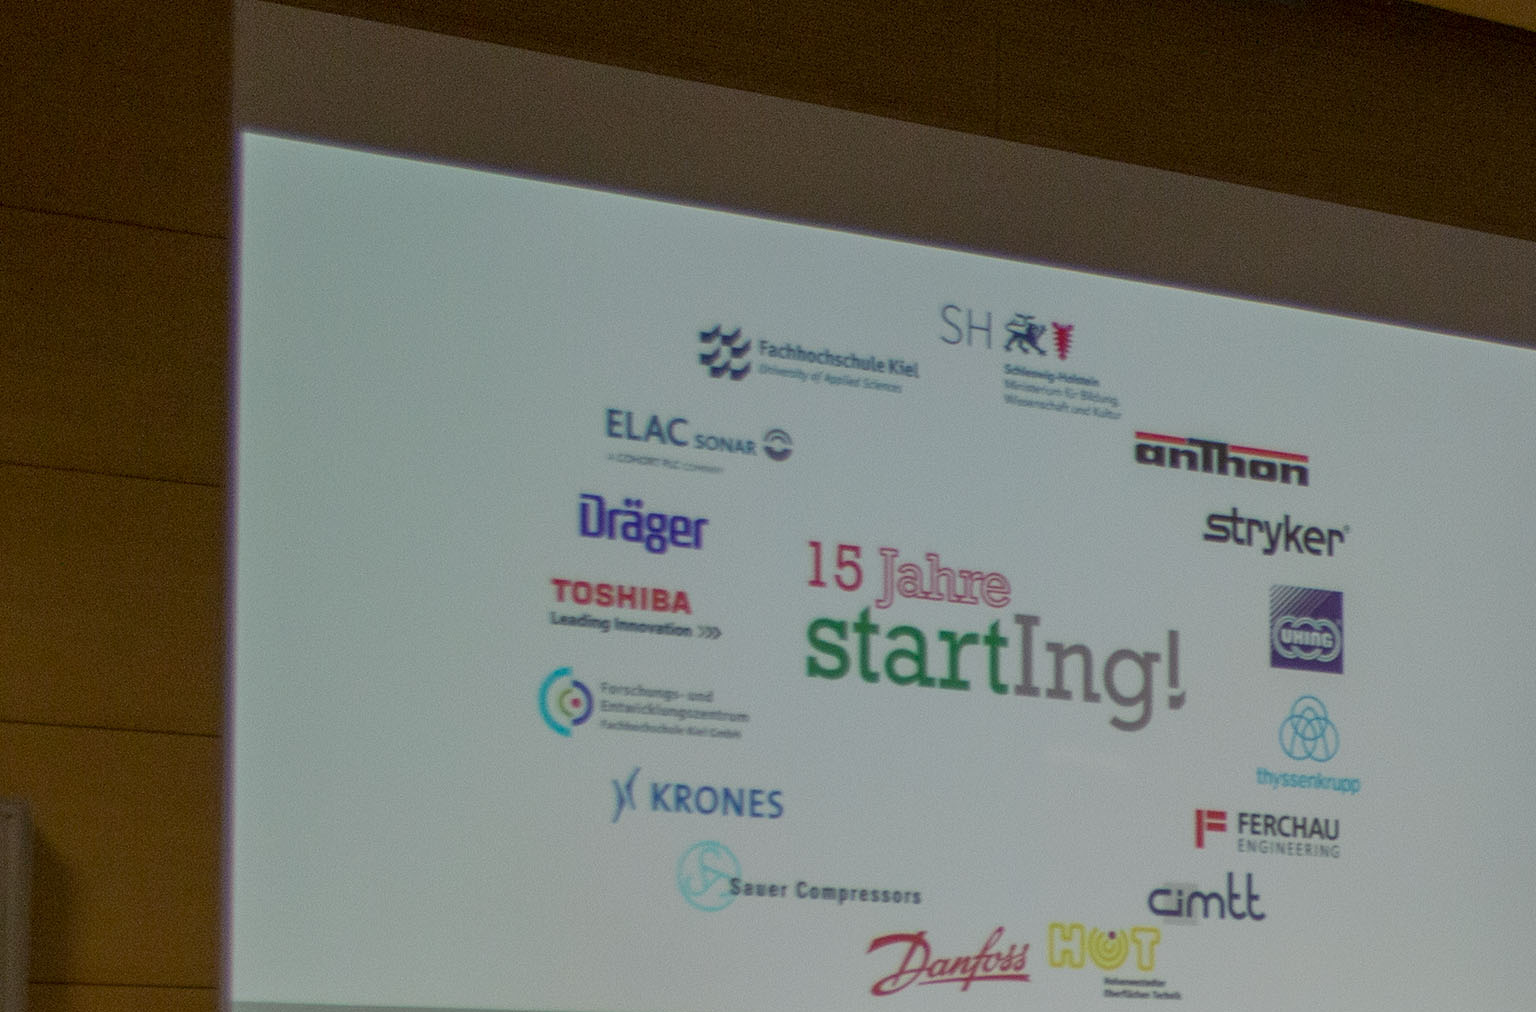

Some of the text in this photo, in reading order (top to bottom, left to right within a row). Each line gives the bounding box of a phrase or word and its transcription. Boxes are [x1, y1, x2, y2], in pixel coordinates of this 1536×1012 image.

[940, 304, 992, 349] SH
[758, 339, 920, 378] Fachhochschule Kiel
[605, 407, 758, 456] ELAC SONAR
[578, 493, 710, 554] Dräger
[807, 540, 1012, 610] 15 Jahre
[551, 578, 692, 615] TOSHIBA
[549, 611, 693, 637] Leading Innovation
[806, 606, 1186, 732] startIng!
[1256, 766, 1361, 795] thyssenkrupp
[650, 782, 784, 819] KRONES
[1237, 812, 1340, 841] FERCHAU
[1236, 838, 1341, 859] ENGINEERING
[729, 877, 922, 905] Sauer Compressors
[1148, 871, 1266, 921] cimtt
[867, 926, 1031, 997] Danfoss
